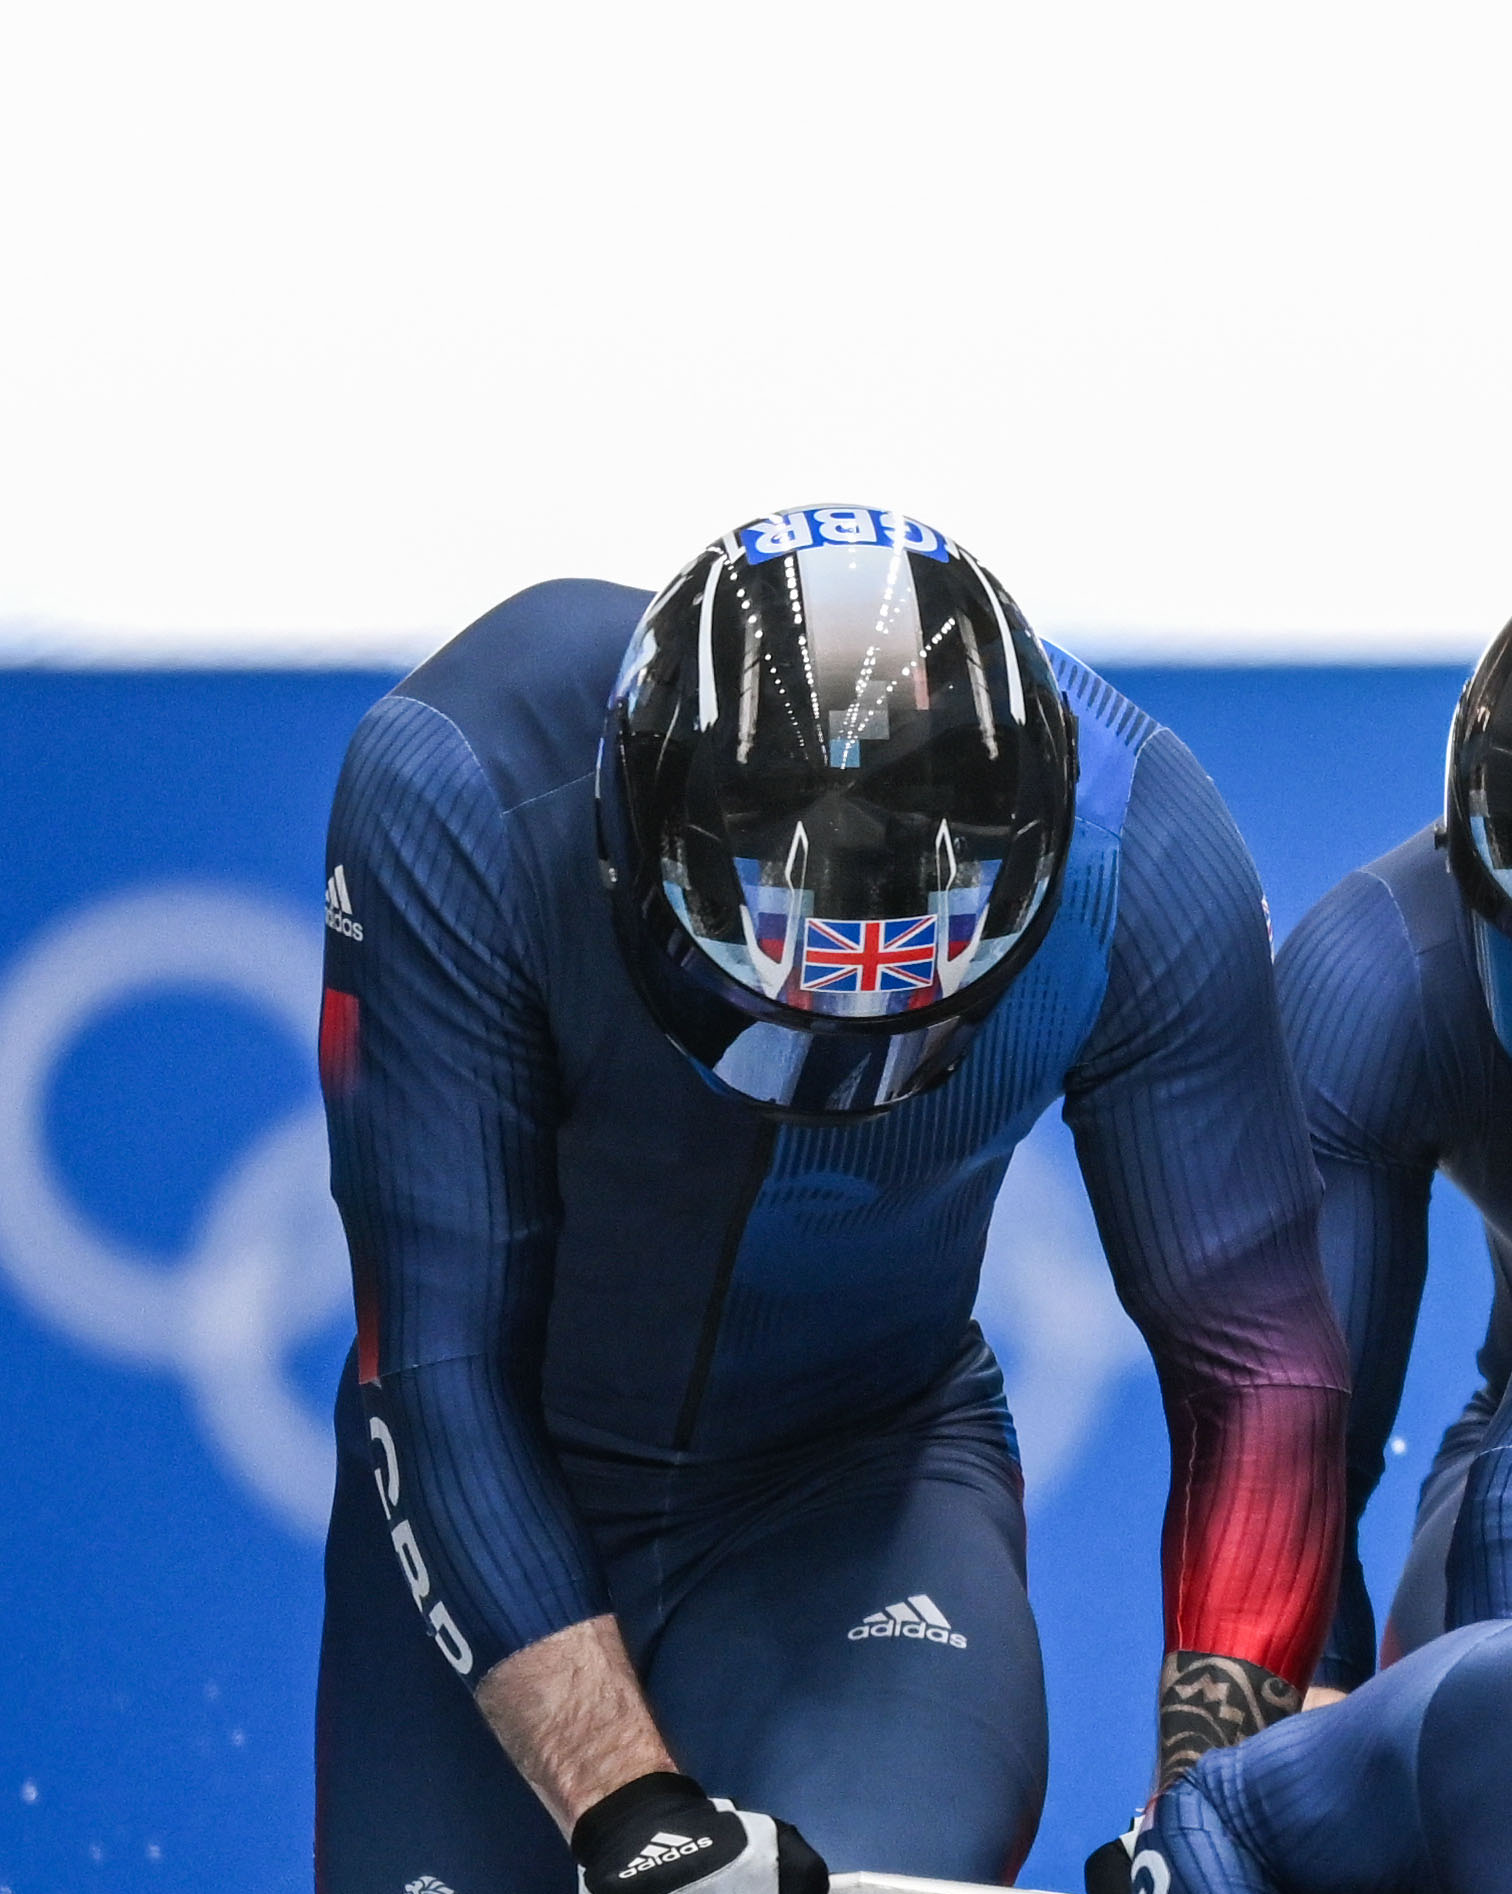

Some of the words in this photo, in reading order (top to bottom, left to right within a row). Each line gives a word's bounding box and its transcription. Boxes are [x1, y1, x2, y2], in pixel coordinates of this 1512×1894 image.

[748, 508, 938, 554] GBR
[847, 1619, 968, 1649] adidas
[618, 1836, 714, 1879] adidas
